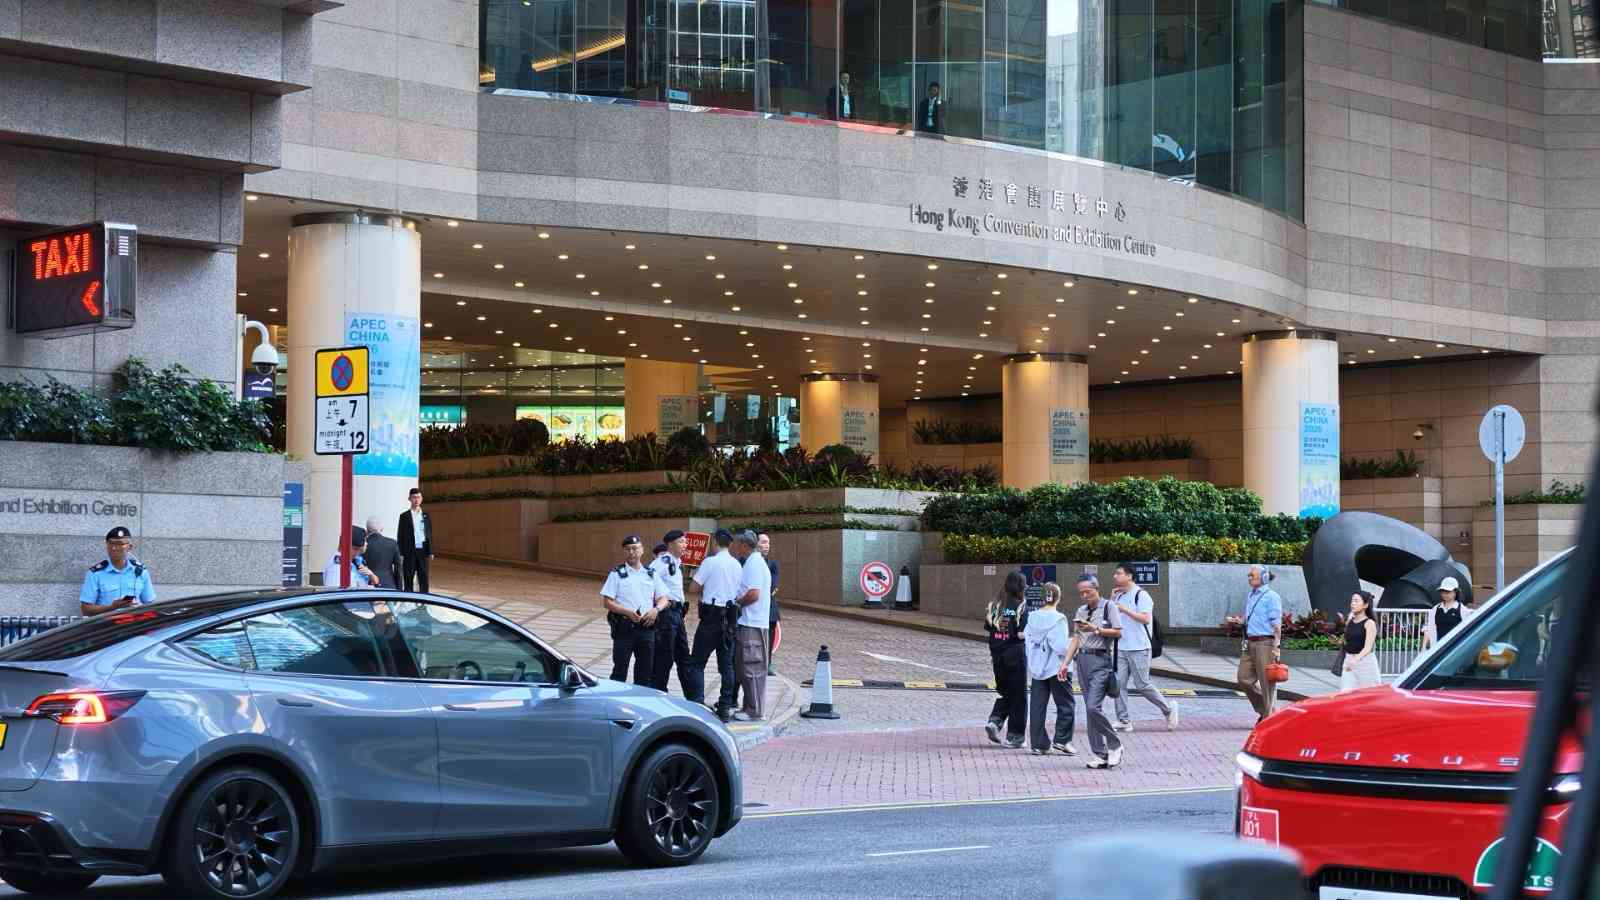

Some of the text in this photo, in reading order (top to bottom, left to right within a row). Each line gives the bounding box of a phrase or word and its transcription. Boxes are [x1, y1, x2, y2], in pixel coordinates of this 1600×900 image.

[952, 176, 1127, 222] 香港會議展覽中心
[910, 204, 1157, 258] Hong Kong Convention and Exhibition Centre
[31, 233, 89, 280] TAXI
[350, 319, 386, 330] APEC
[350, 330, 390, 343] CHINA
[349, 400, 358, 418] 7
[1304, 408, 1328, 416] APEC
[1303, 416, 1328, 425] CHINA
[350, 431, 365, 450] 12
[0, 498, 137, 517] nd Exhibition Centre
